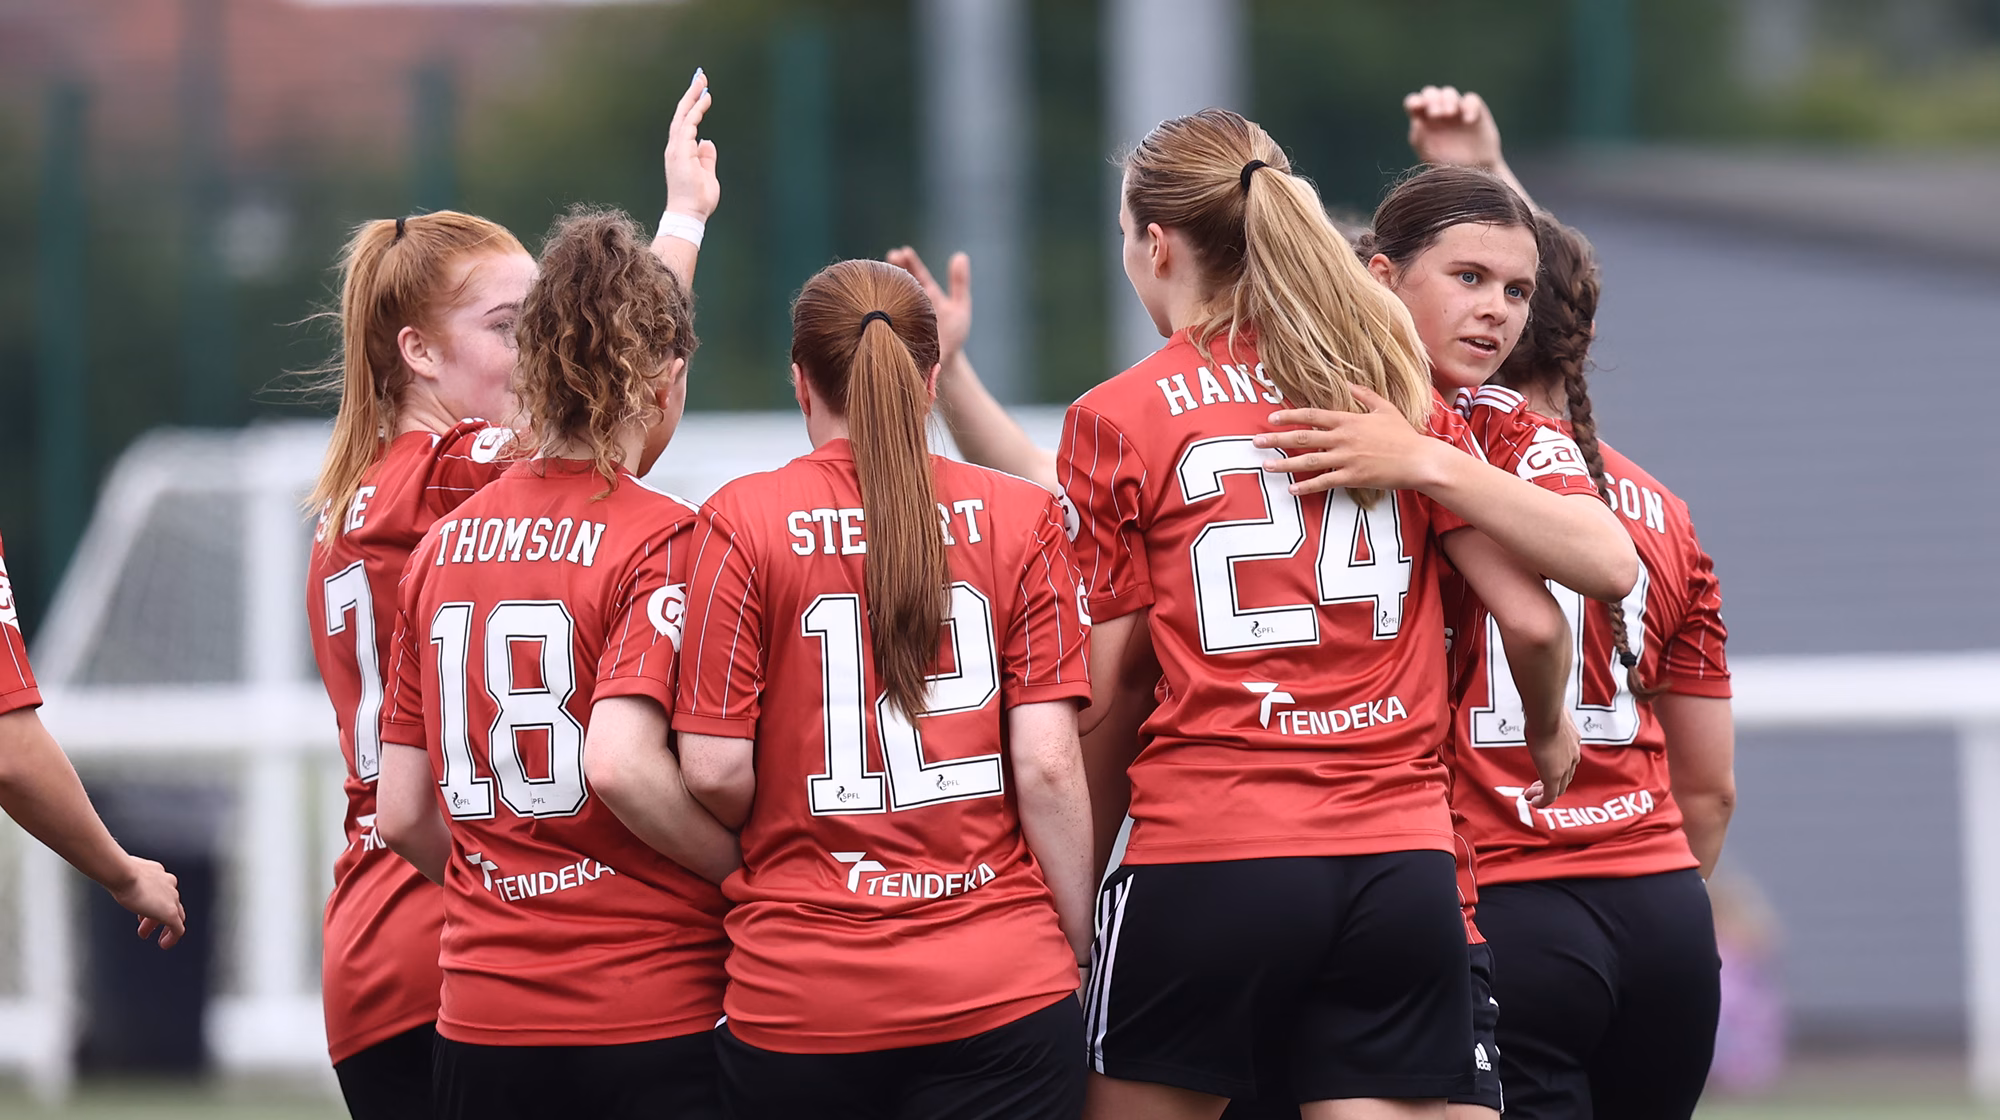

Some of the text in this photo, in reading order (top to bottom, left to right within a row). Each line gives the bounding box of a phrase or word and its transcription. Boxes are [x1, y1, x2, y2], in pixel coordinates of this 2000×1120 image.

[1156, 362, 1284, 417] HANS
[435, 516, 606, 567] THOMSON
[786, 498, 985, 556] STERT
[1177, 434, 1413, 655] 24
[1257, 626, 1275, 634] SPFL
[324, 559, 383, 783] 7
[430, 599, 589, 820] 18
[801, 580, 1004, 816] 12
[1276, 695, 1408, 735] TENDEKA
[942, 779, 960, 787] SPFL
[1537, 789, 1654, 830] TENDEKA
[494, 858, 616, 902] TENDEKA
[866, 862, 997, 899] TENDEKA
